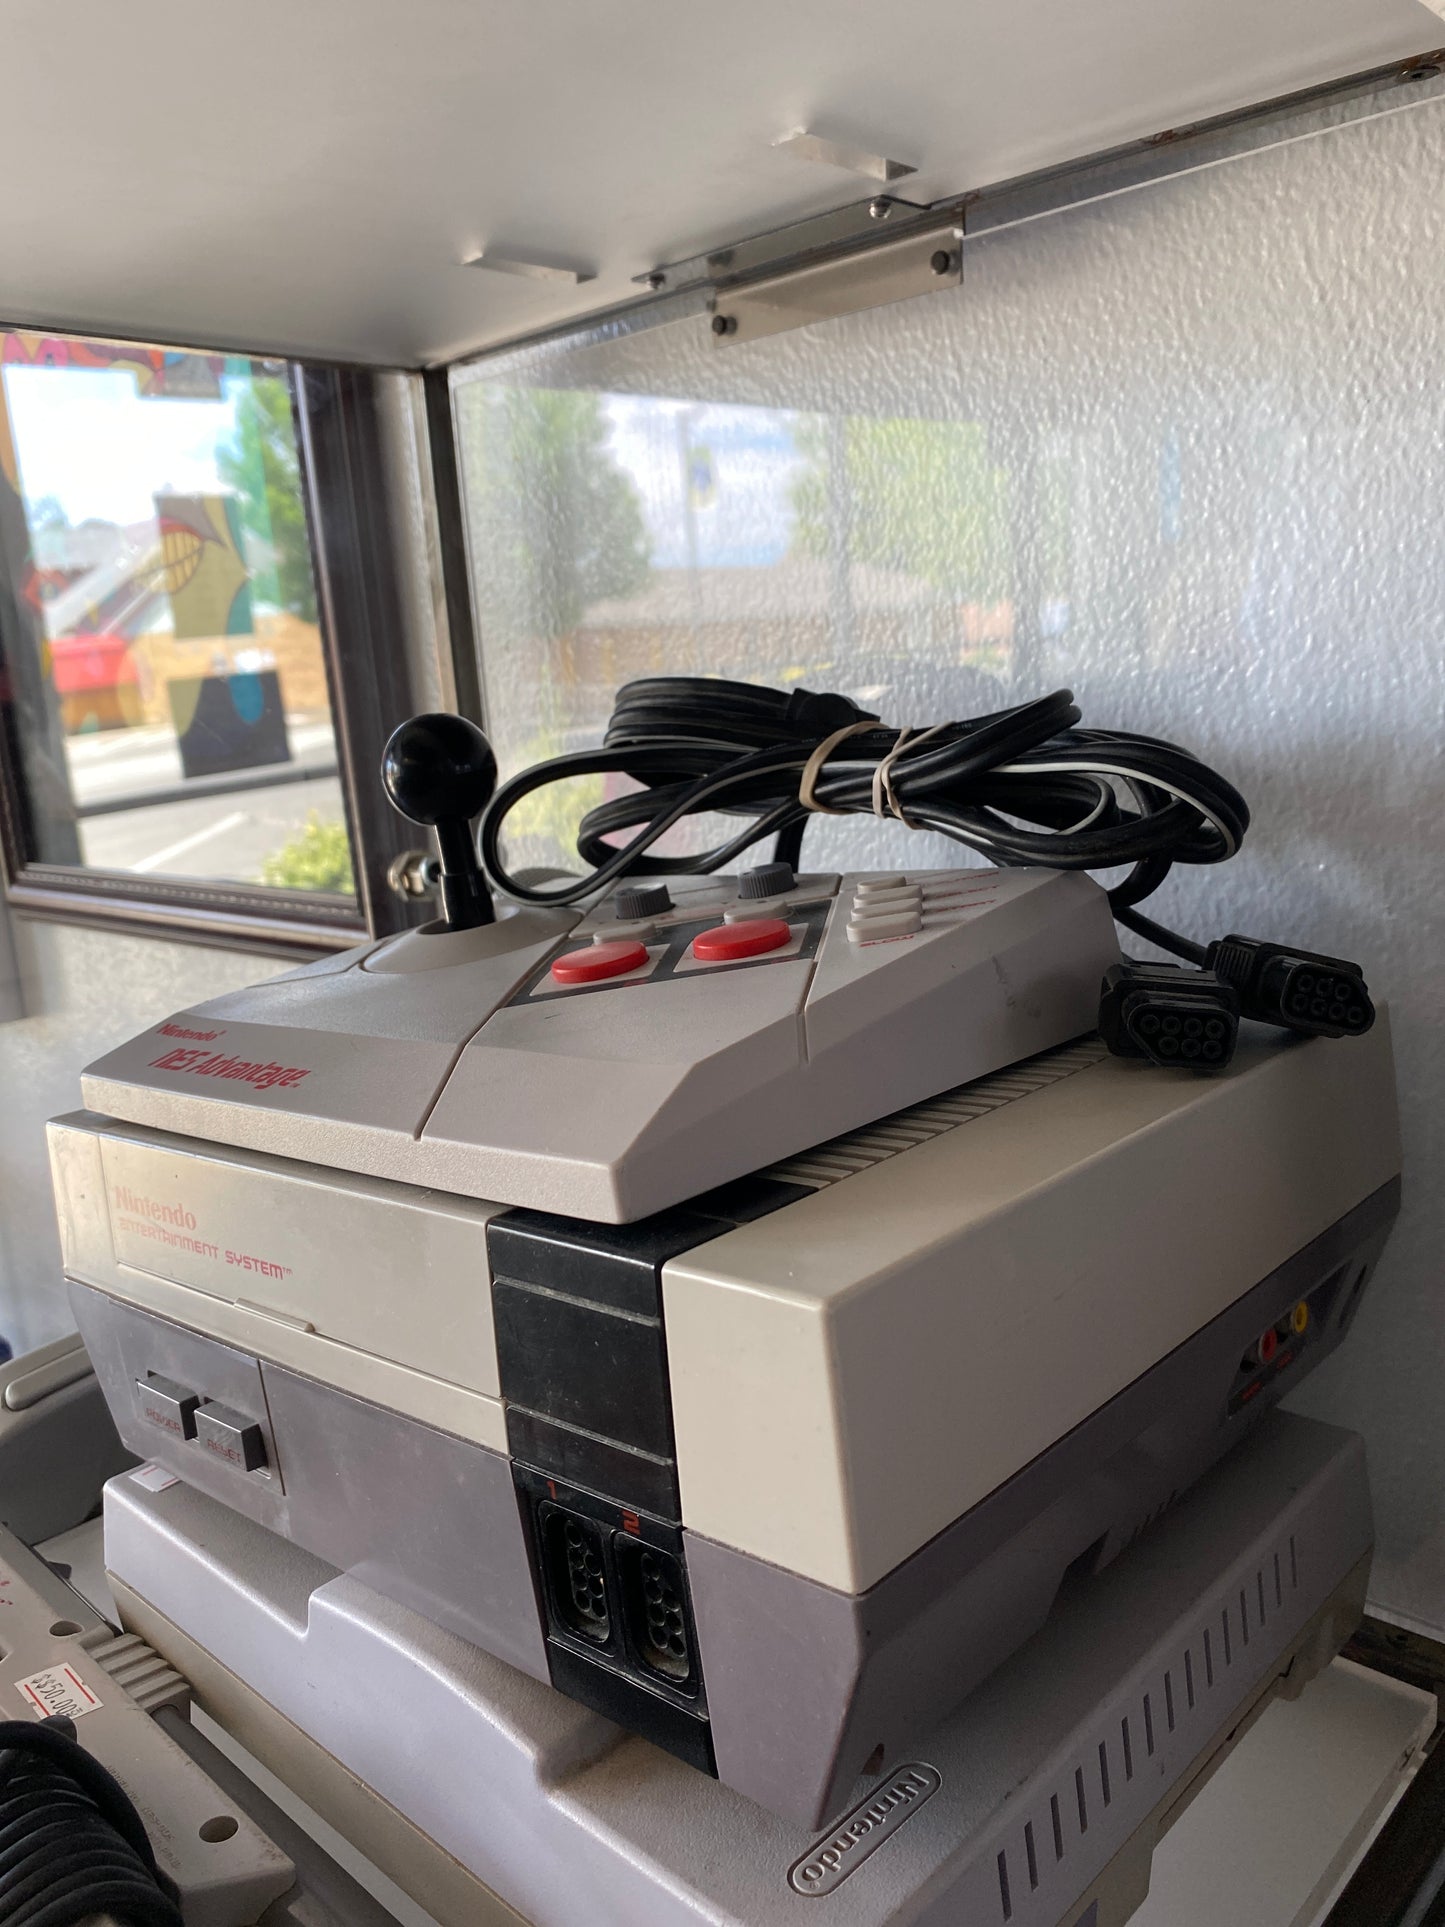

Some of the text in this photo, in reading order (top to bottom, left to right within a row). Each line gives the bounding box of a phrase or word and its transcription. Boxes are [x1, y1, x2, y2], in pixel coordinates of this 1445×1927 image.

[156, 1023, 219, 1042] Nintendo
[146, 1047, 212, 1071] NES
[114, 1185, 197, 1232] Nintendo
[117, 1217, 220, 1260] ENTERTAINMENT
[145, 1407, 181, 1433] POWER
[207, 1438, 241, 1463] RESET
[546, 1480, 557, 1500] 1
[621, 1509, 641, 1536] 2
[801, 1770, 930, 1882] Nintendo
